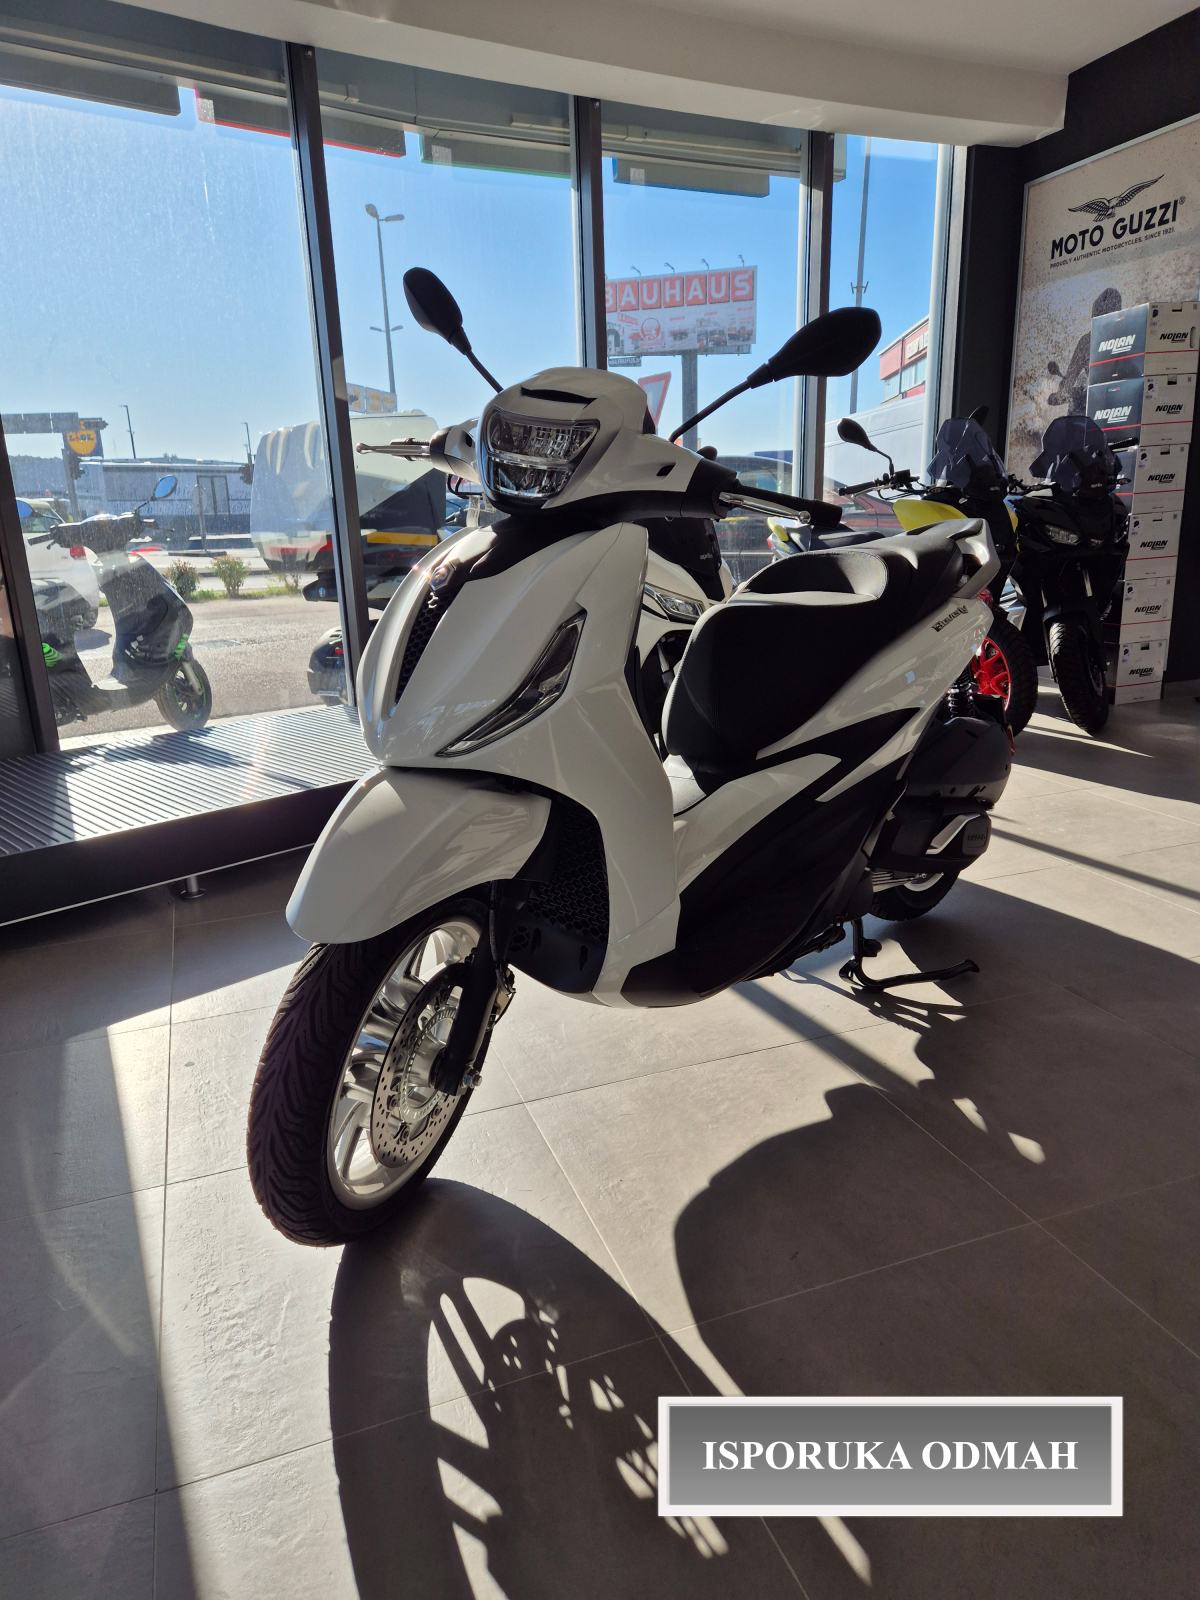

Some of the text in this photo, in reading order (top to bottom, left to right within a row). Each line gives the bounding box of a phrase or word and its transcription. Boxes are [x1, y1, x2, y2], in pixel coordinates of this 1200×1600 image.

[1051, 199, 1179, 260] MOTO GUZZI
[1160, 332, 1189, 343] NOLAN
[1098, 334, 1136, 354] NOLAN
[1094, 405, 1133, 424] NOLAN
[1156, 404, 1184, 414] NOLAN
[1147, 473, 1176, 484] NOLAN
[1140, 540, 1168, 551] NOLAN
